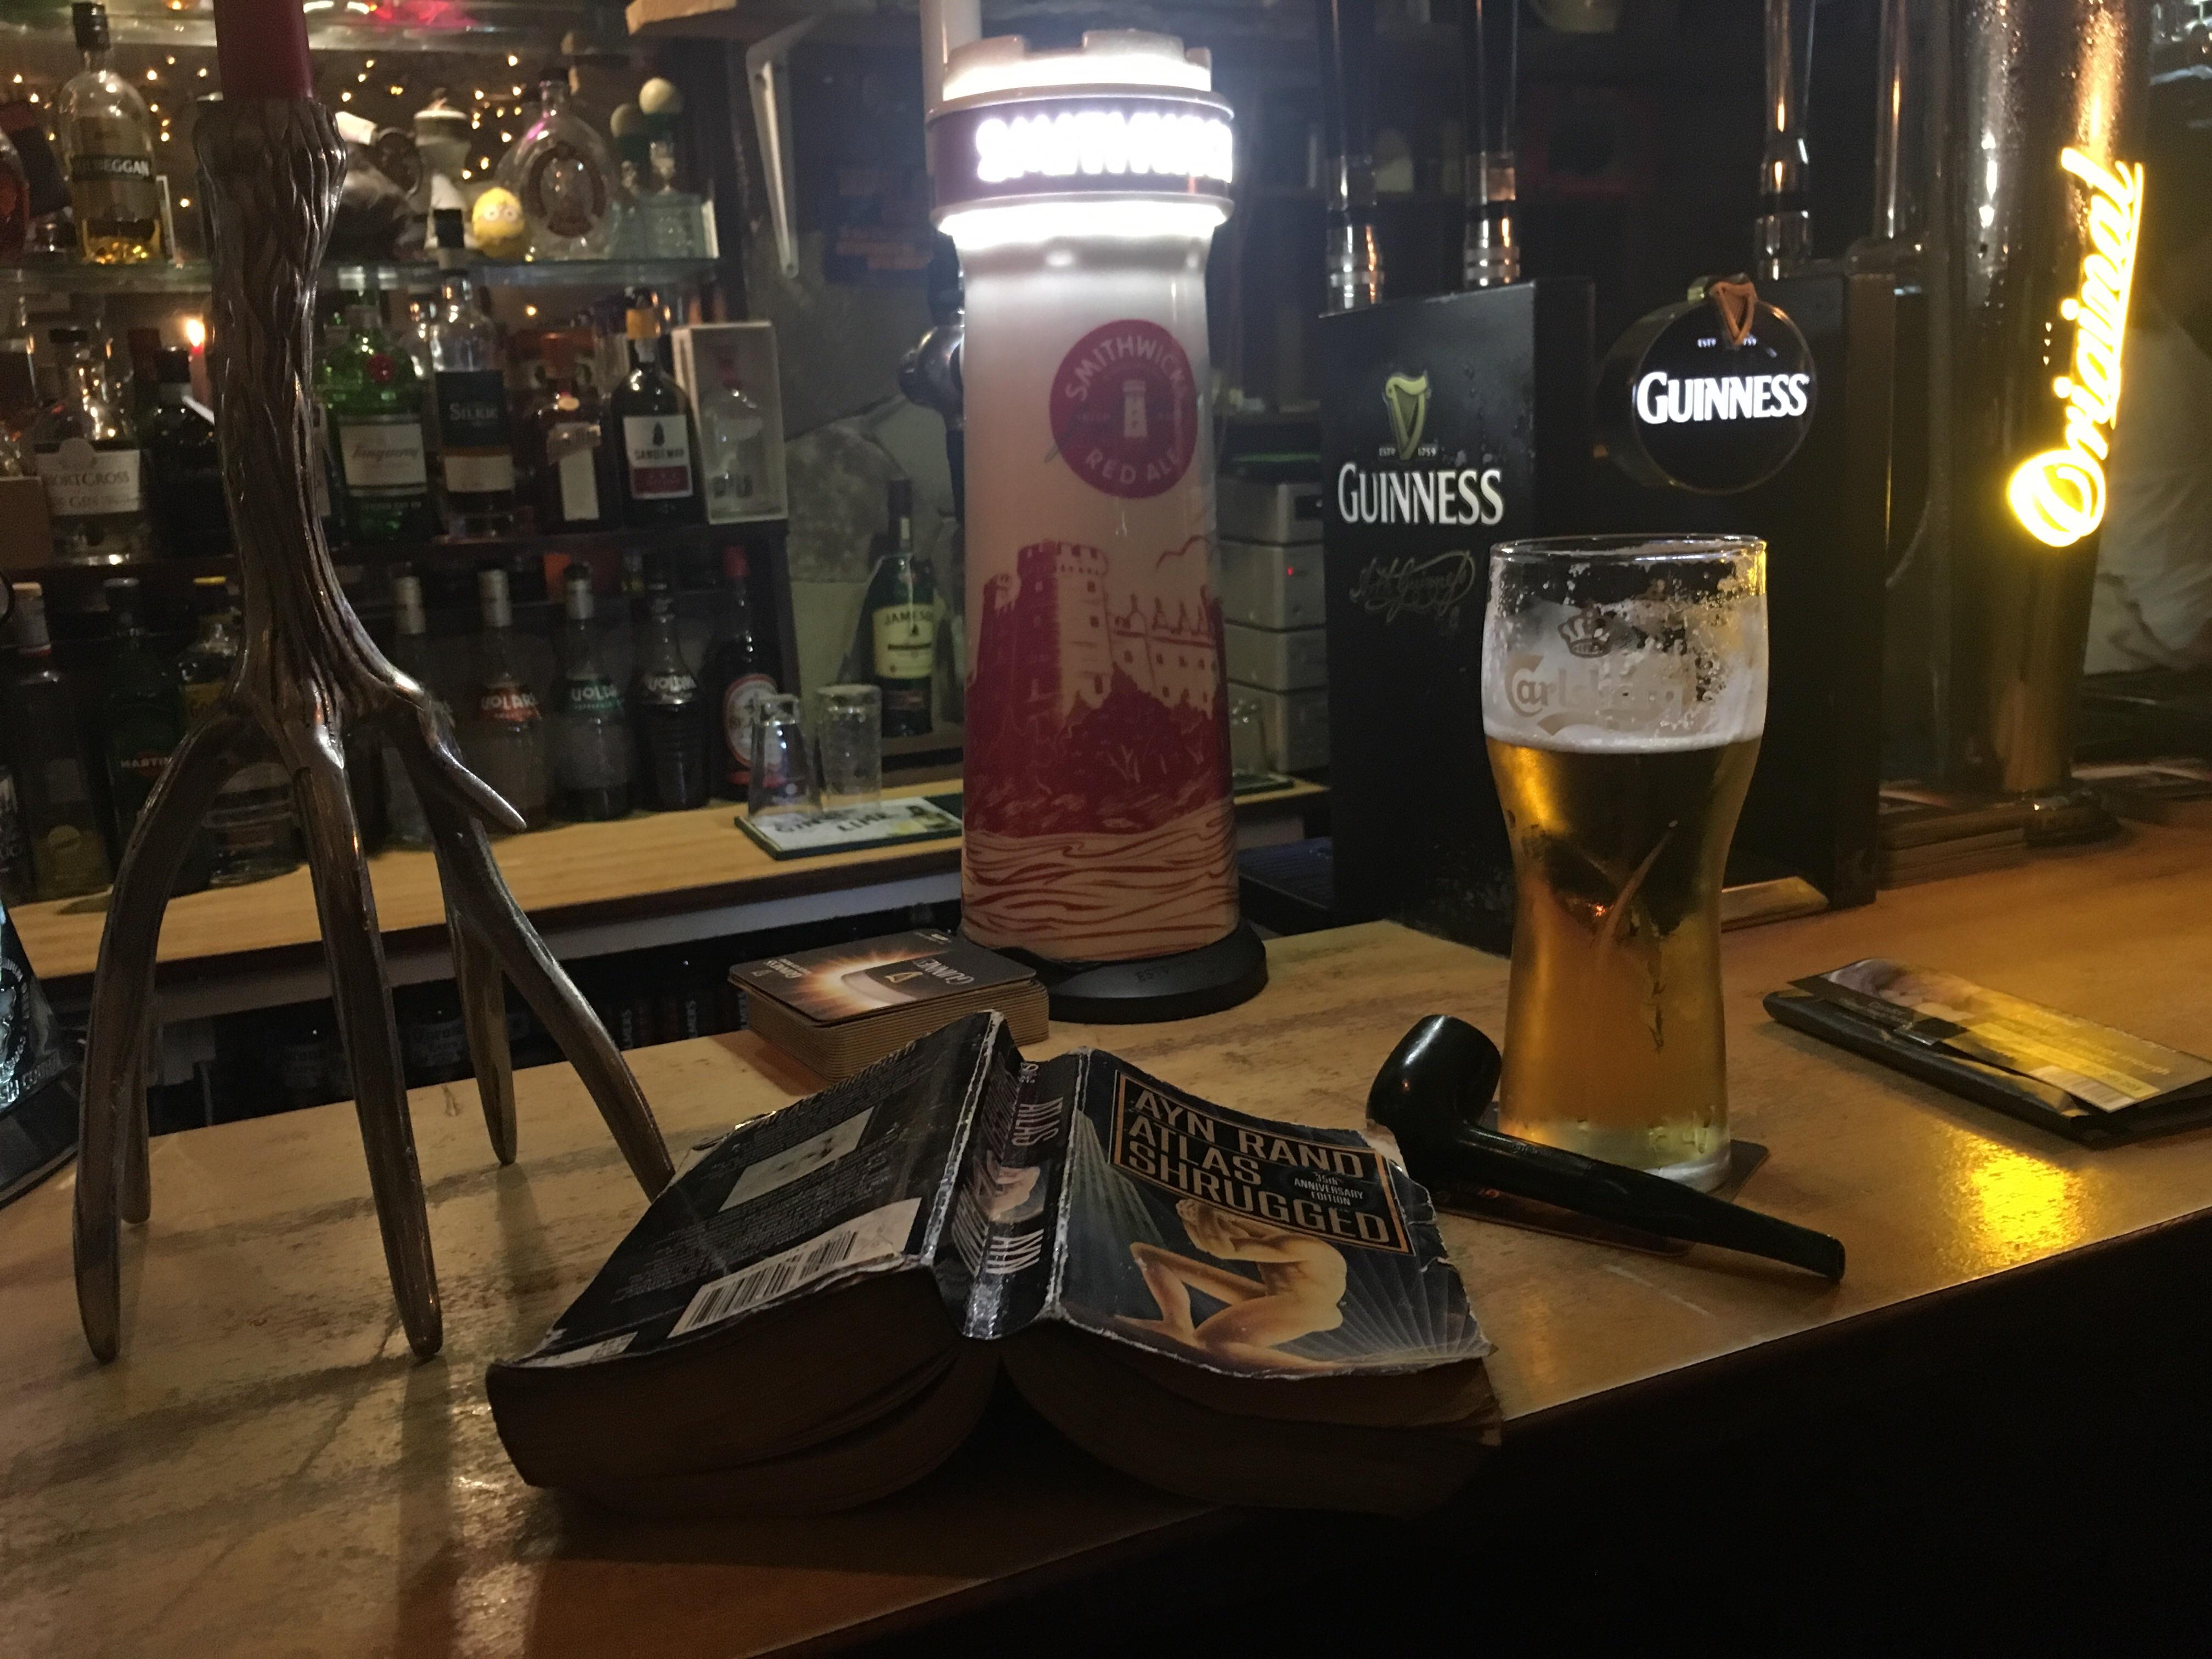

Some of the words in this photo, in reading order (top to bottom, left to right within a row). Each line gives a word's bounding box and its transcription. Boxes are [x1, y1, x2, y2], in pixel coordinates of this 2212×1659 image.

[1637, 371, 1810, 425] GUINNESS
[1085, 449, 1137, 485] RED
[1146, 447, 1181, 484] ALE
[1337, 461, 1504, 526] GUINNESS
[1012, 1097, 1064, 1147] ATLAS
[1133, 1090, 1216, 1144] AYN
[1238, 1128, 1365, 1180] RAND
[1128, 1116, 1262, 1187] ATLAS
[1128, 1139, 1391, 1245] SHRUGGED
[1294, 1177, 1363, 1200] ANNIVERSARY
[1311, 1190, 1351, 1206] EDITION
[985, 1228, 1044, 1275] AYN
